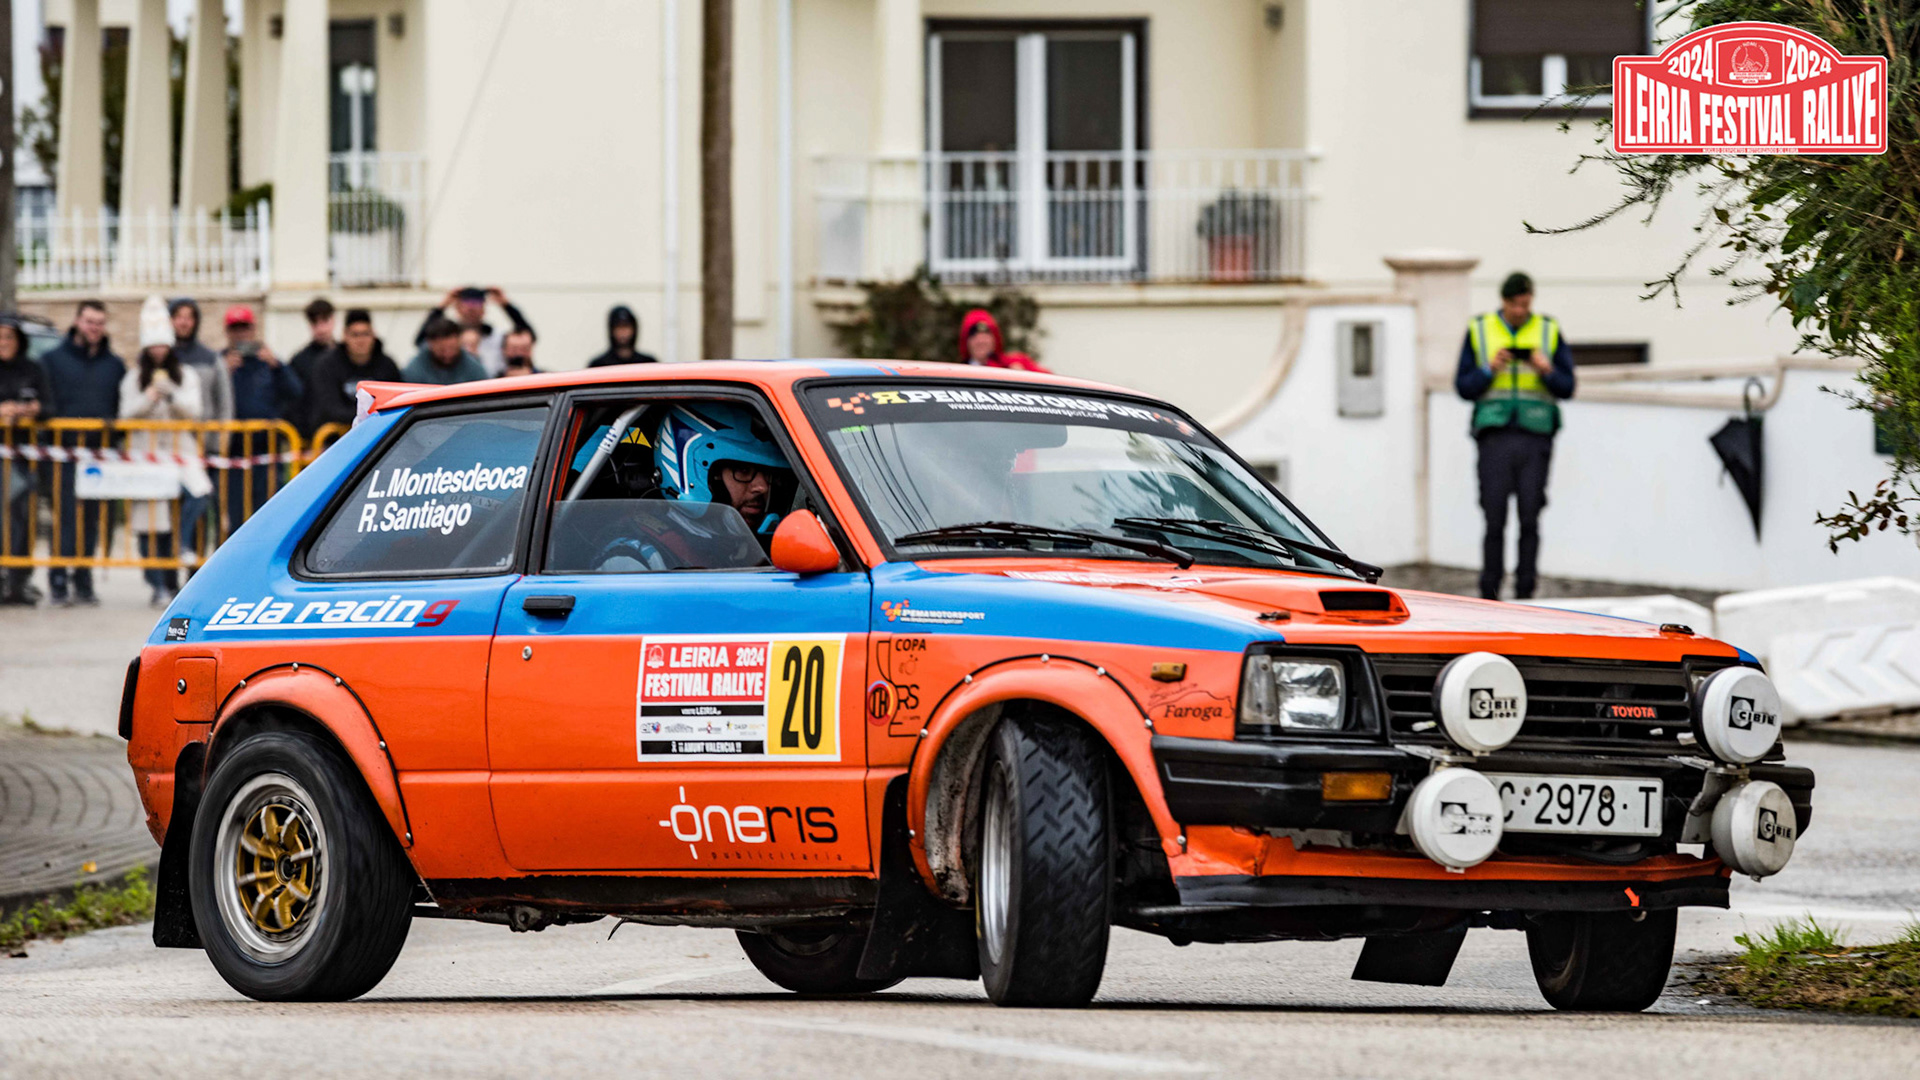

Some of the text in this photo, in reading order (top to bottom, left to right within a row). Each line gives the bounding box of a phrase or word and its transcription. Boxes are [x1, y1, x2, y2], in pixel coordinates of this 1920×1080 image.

[208, 594, 462, 627] isla racing
[895, 638, 926, 652] COPA
[669, 646, 730, 668] LEIRIA
[736, 647, 765, 667] 2024
[644, 671, 764, 697] FESTIVAL RALLYE
[780, 645, 825, 750] 20
[1164, 704, 1223, 721] Faroga
[1611, 705, 1656, 719] TOYOTA
